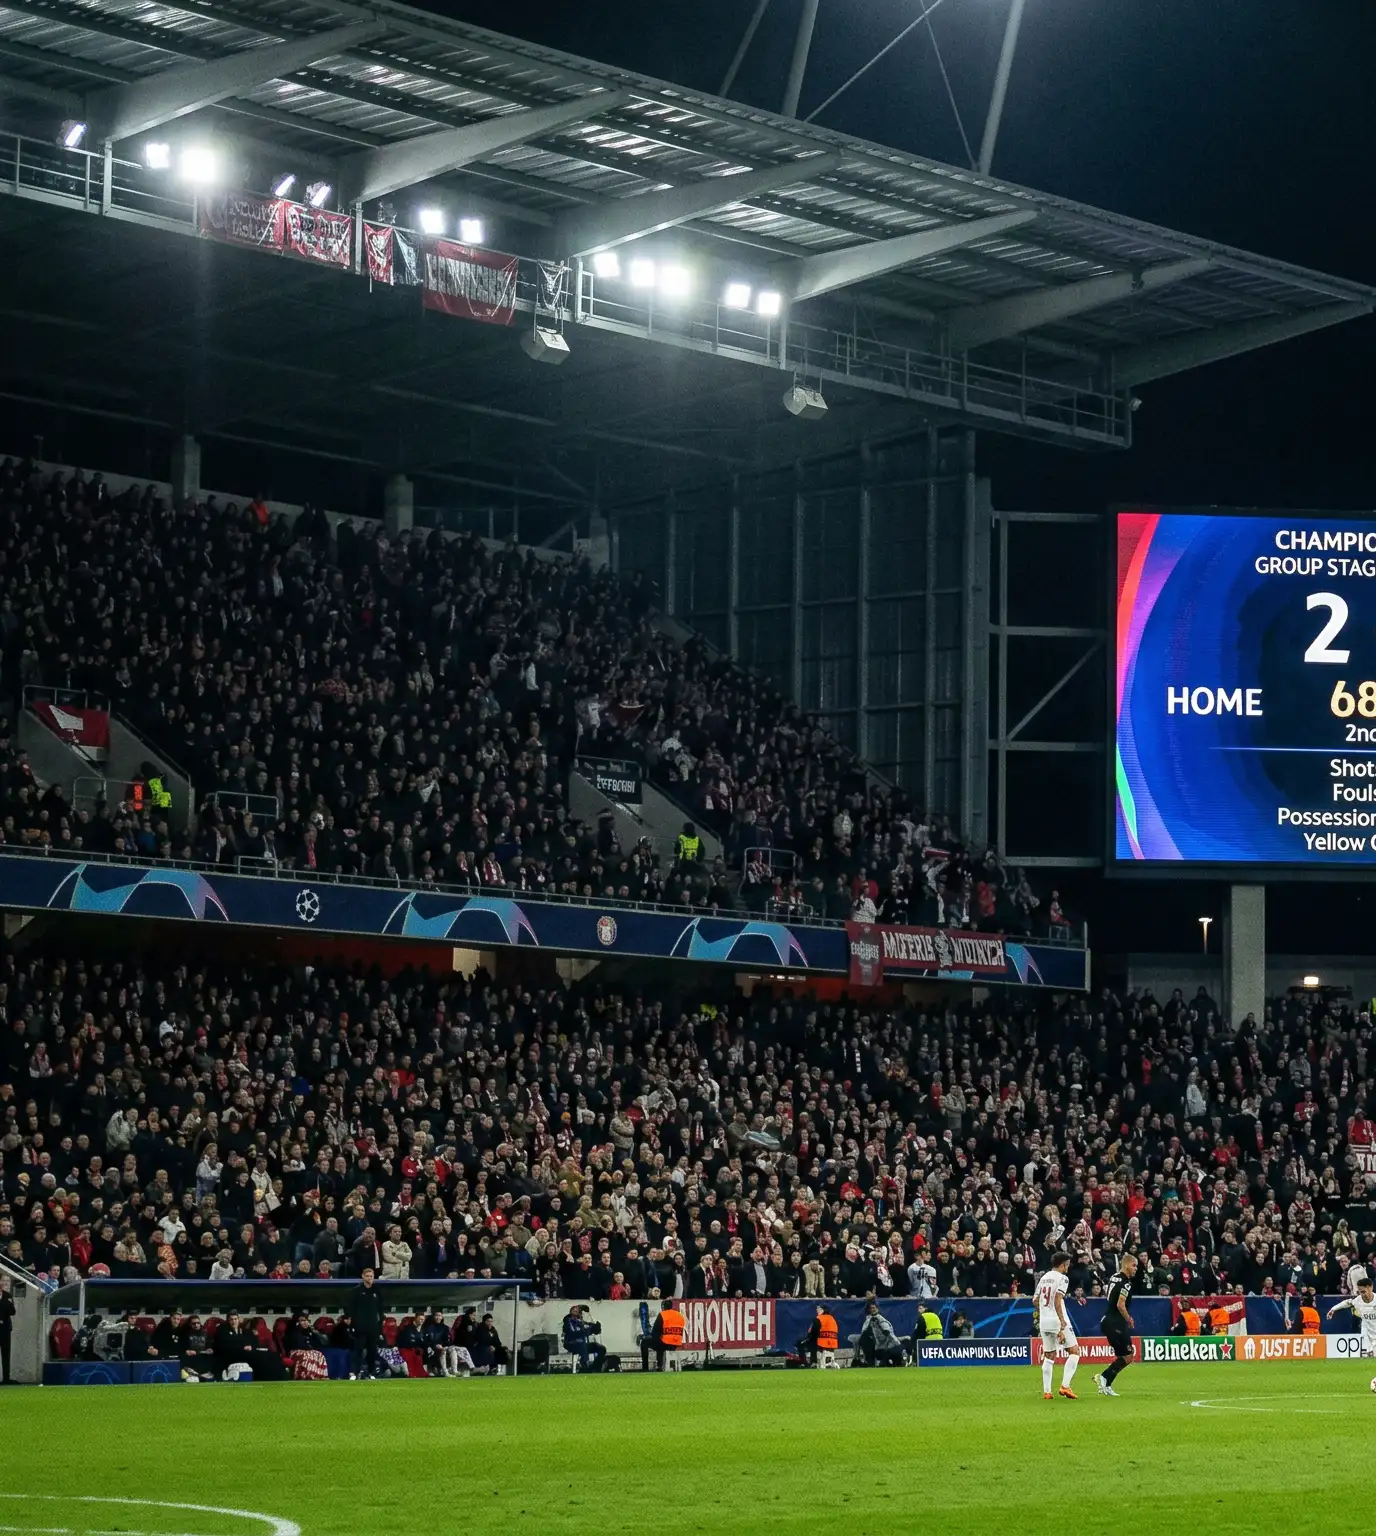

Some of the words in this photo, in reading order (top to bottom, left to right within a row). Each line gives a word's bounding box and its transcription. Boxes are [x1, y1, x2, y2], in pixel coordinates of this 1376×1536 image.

[1255, 556, 1323, 576] GROUP
[1303, 592, 1351, 664] 2
[1167, 686, 1263, 716] HOME
[1303, 832, 1366, 851] Yellow
[921, 1347, 944, 1359] UEFA
[996, 1345, 1028, 1358] LEAGUE
[1143, 1338, 1219, 1361] Heineken
[1259, 1338, 1290, 1360] JUST
[1292, 1337, 1317, 1357] EAT
